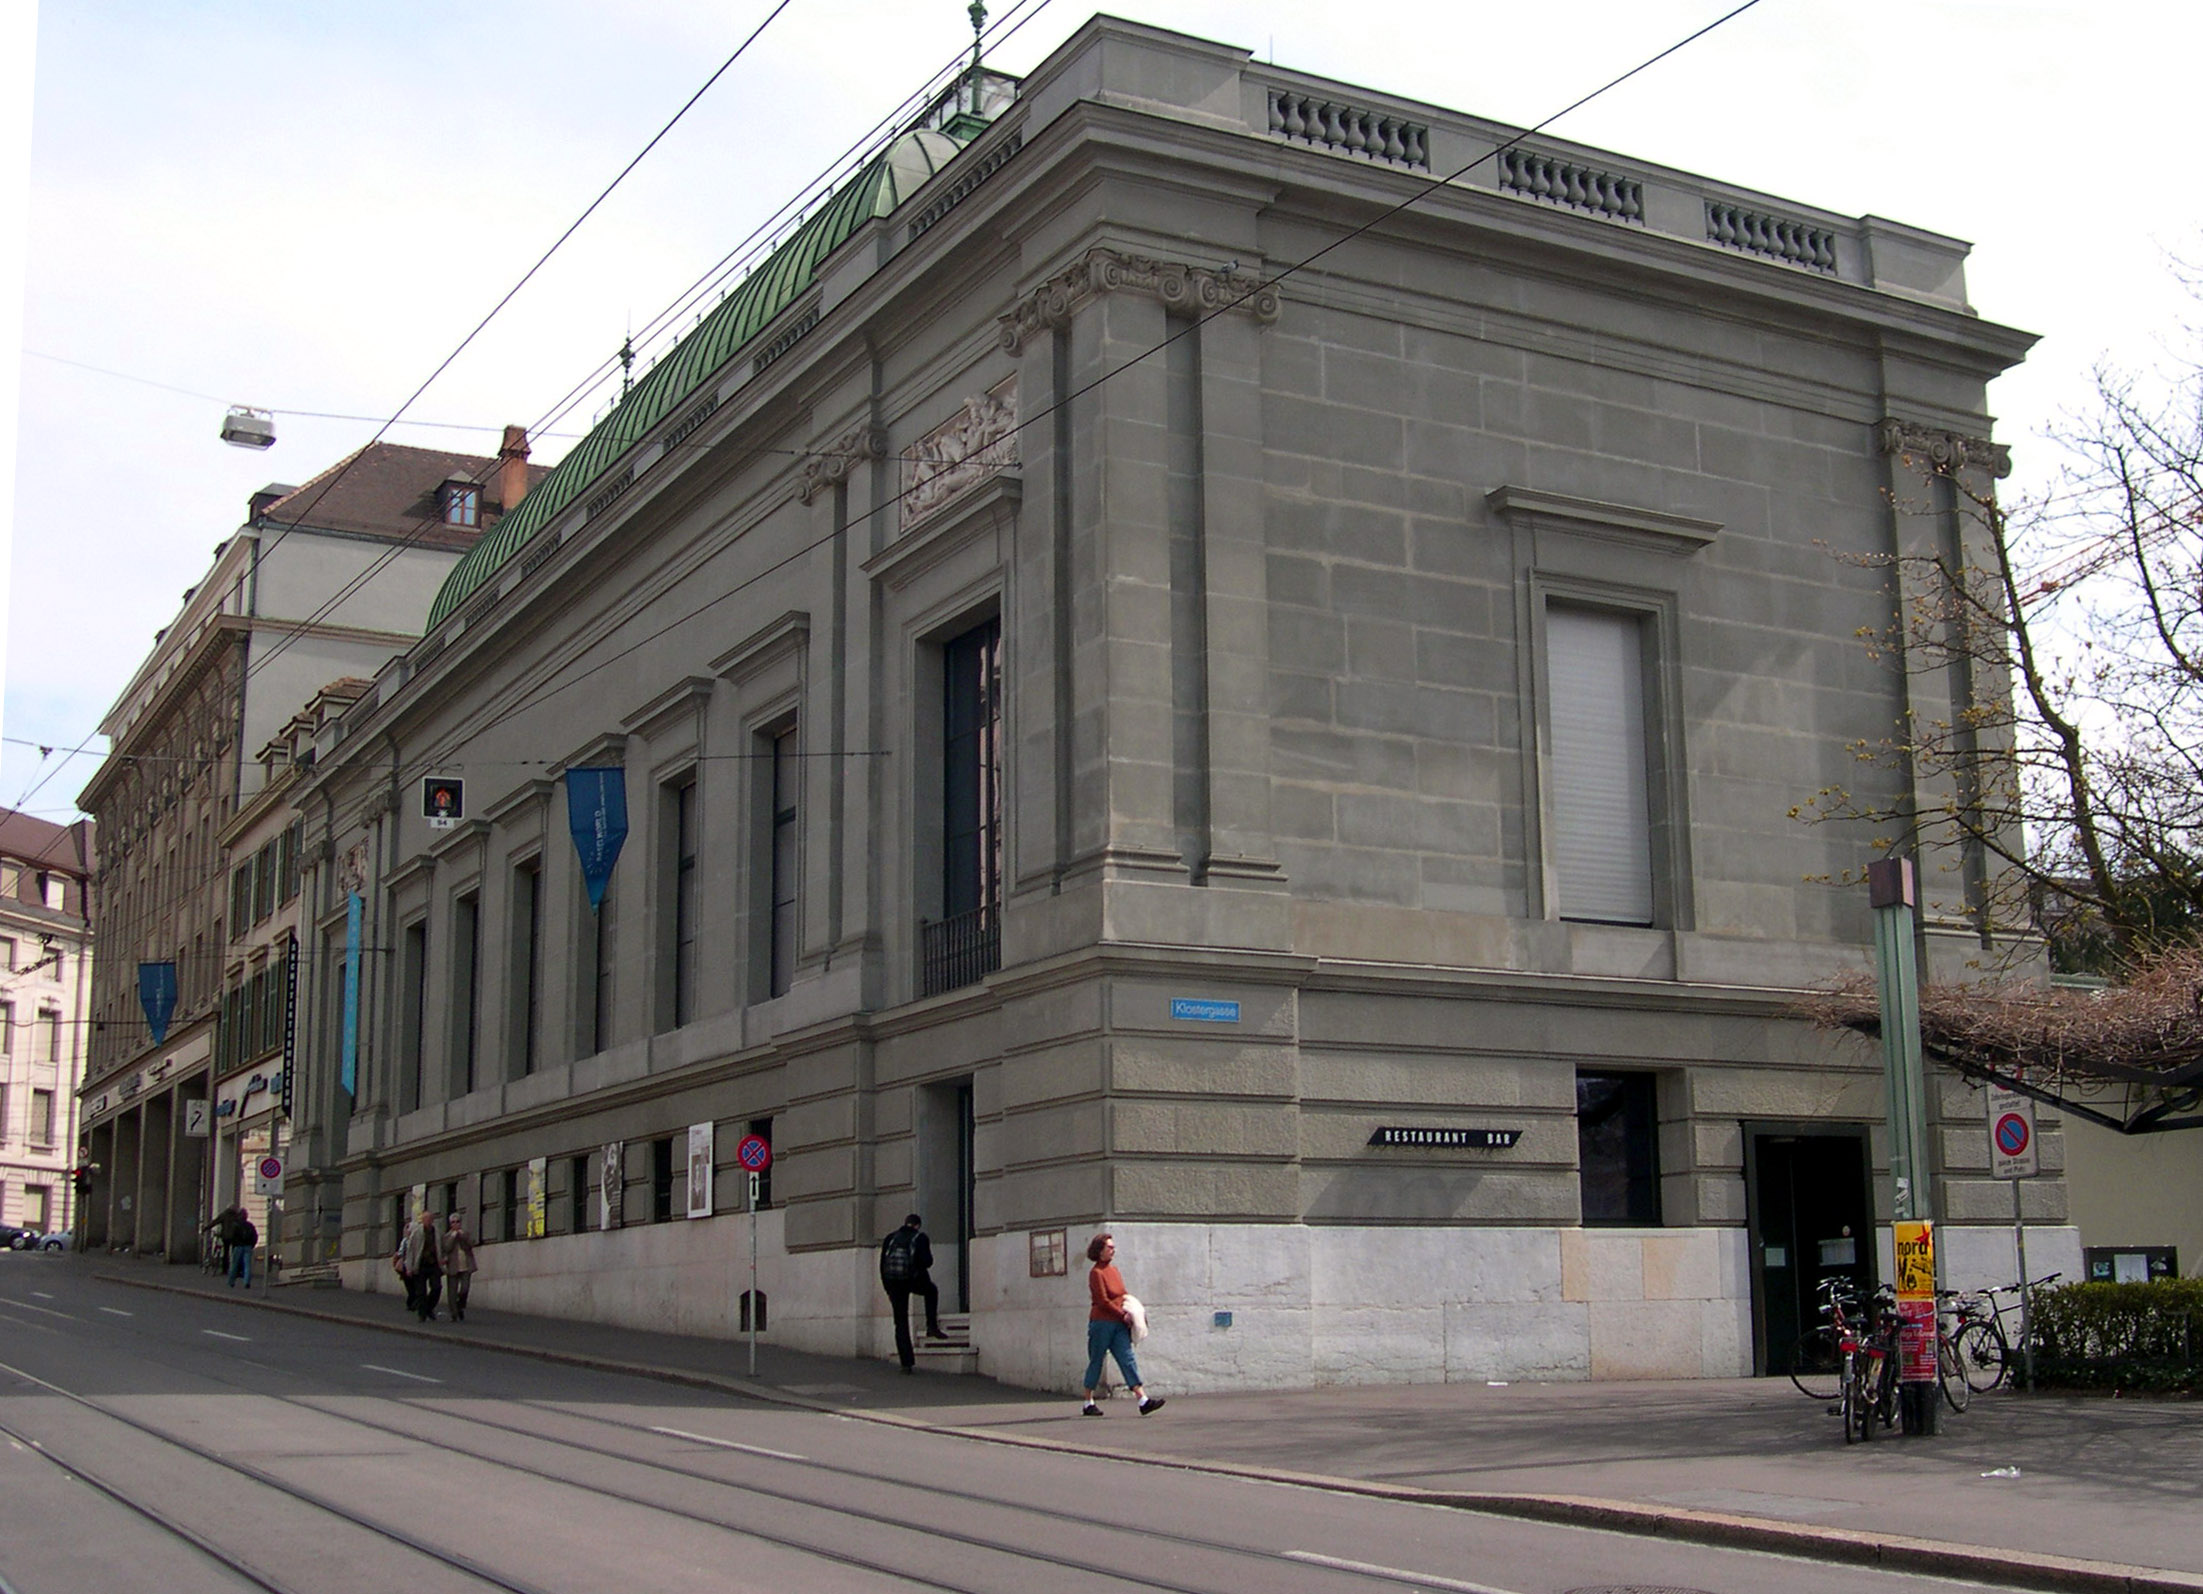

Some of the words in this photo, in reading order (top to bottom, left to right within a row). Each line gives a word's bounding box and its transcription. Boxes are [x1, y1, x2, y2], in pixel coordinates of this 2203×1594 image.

[1176, 1001, 1237, 1019] Klostergasse
[1385, 1130, 1467, 1143] RESTAURANT
[1487, 1133, 1511, 1145] BAR
